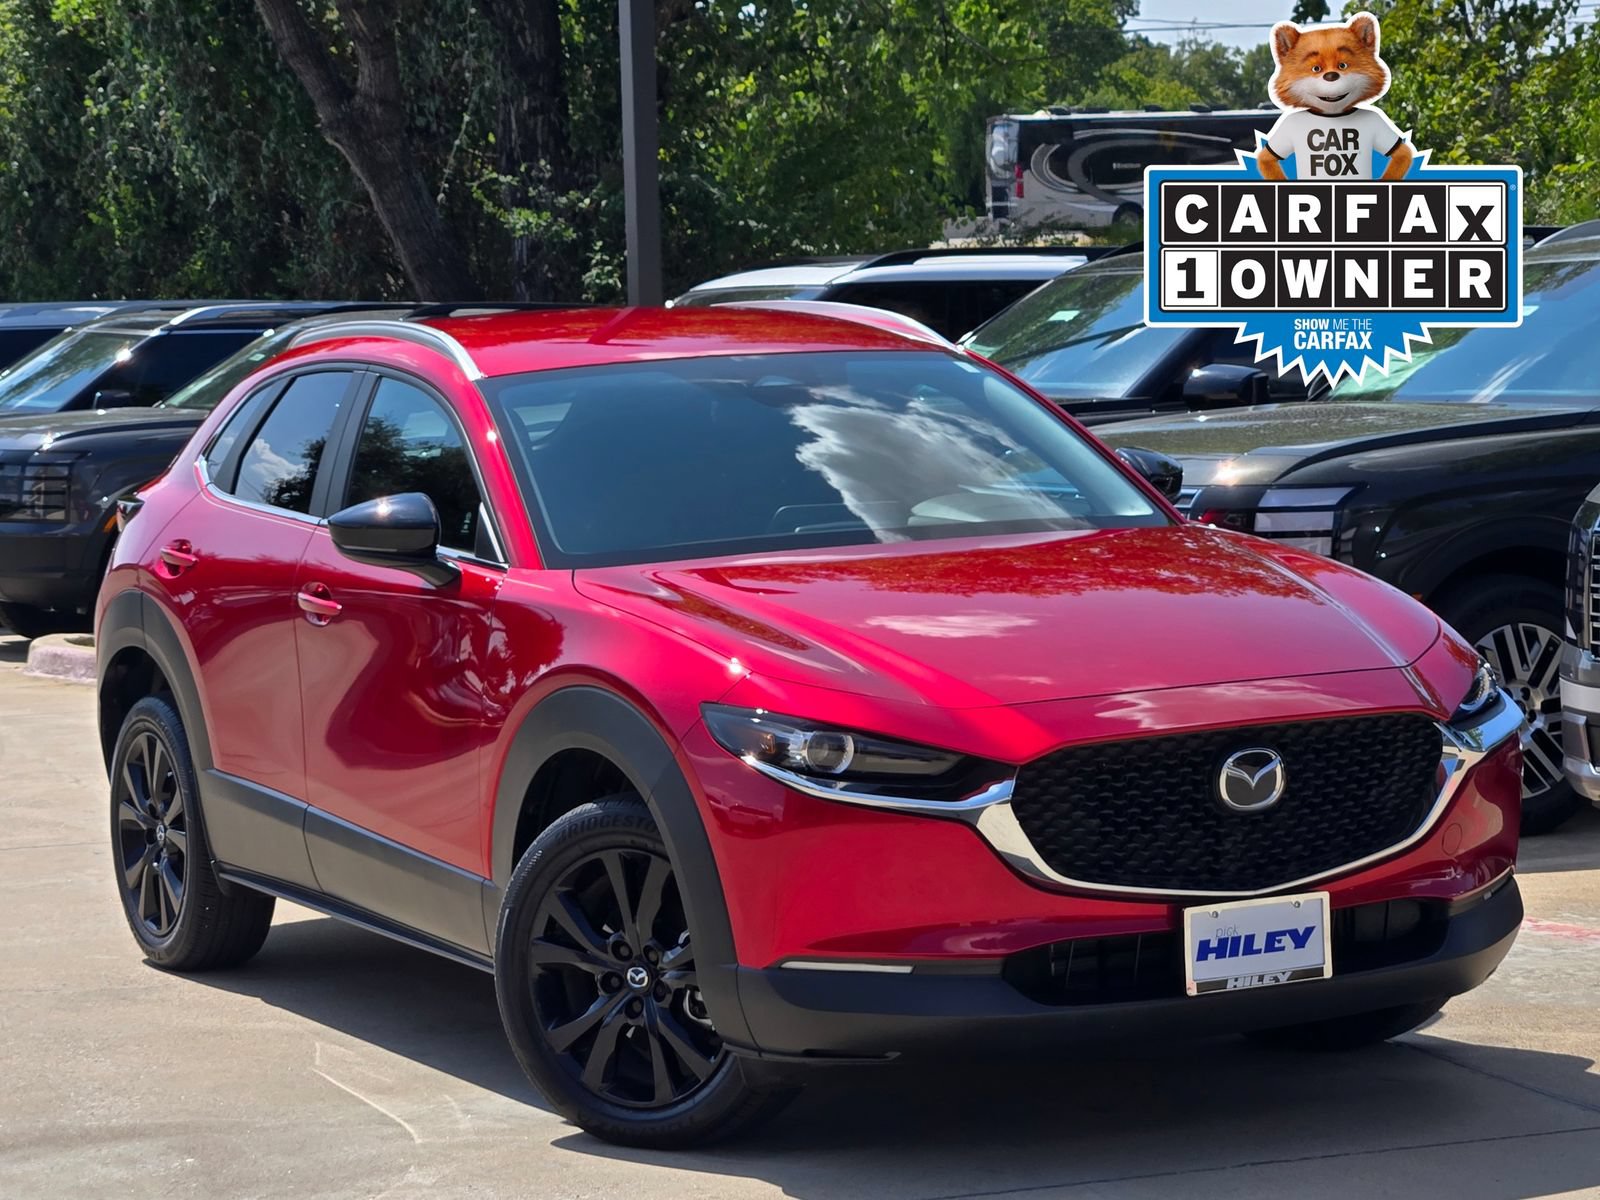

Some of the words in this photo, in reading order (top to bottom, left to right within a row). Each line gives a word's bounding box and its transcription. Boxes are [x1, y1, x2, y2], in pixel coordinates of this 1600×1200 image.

[554, 814, 660, 845] BRIDGESTO
[1196, 926, 1316, 962] HILEY
[1226, 971, 1294, 990] HILEY
